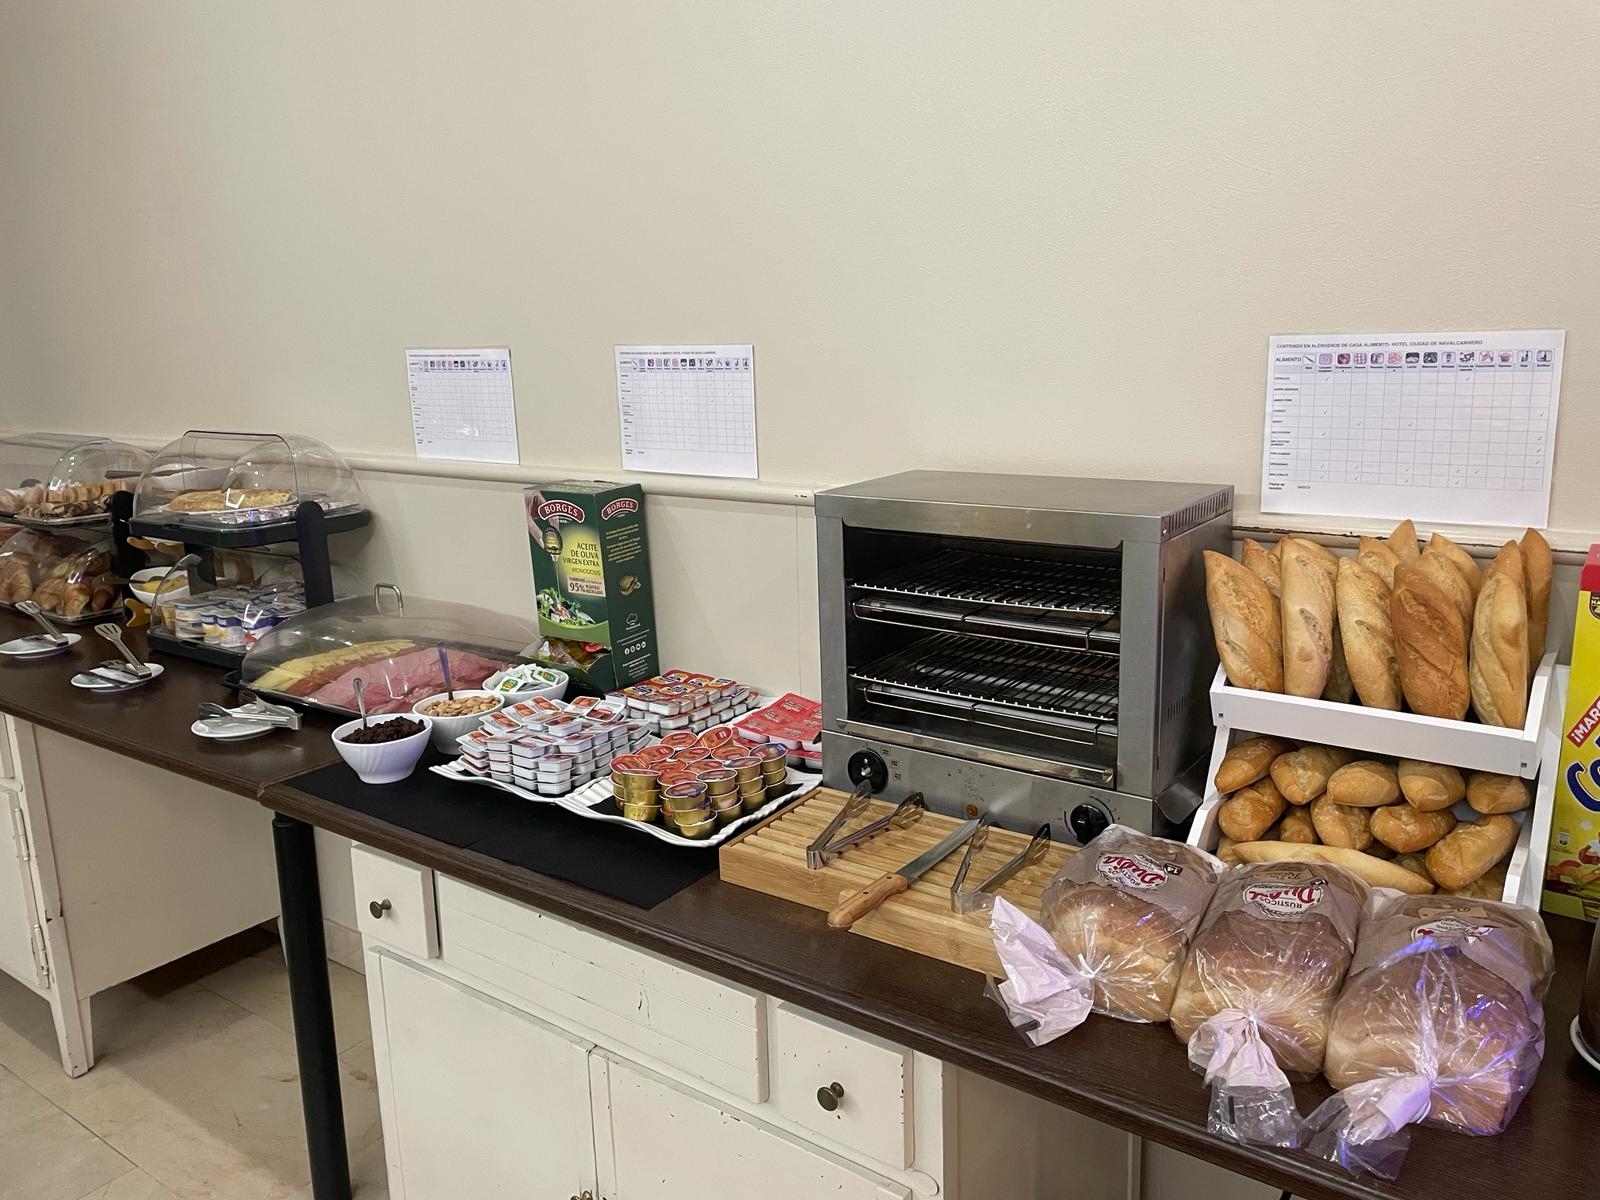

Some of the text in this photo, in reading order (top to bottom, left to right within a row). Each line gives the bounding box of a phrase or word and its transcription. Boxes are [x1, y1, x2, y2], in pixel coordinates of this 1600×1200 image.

[544, 503, 578, 517] BORGES
[606, 500, 634, 515] BORGES
[577, 542, 598, 551] ACEITE
[570, 549, 599, 560] DE OLIVA
[563, 557, 600, 567] VIRGEN EXTRA
[569, 582, 586, 593] 95%
